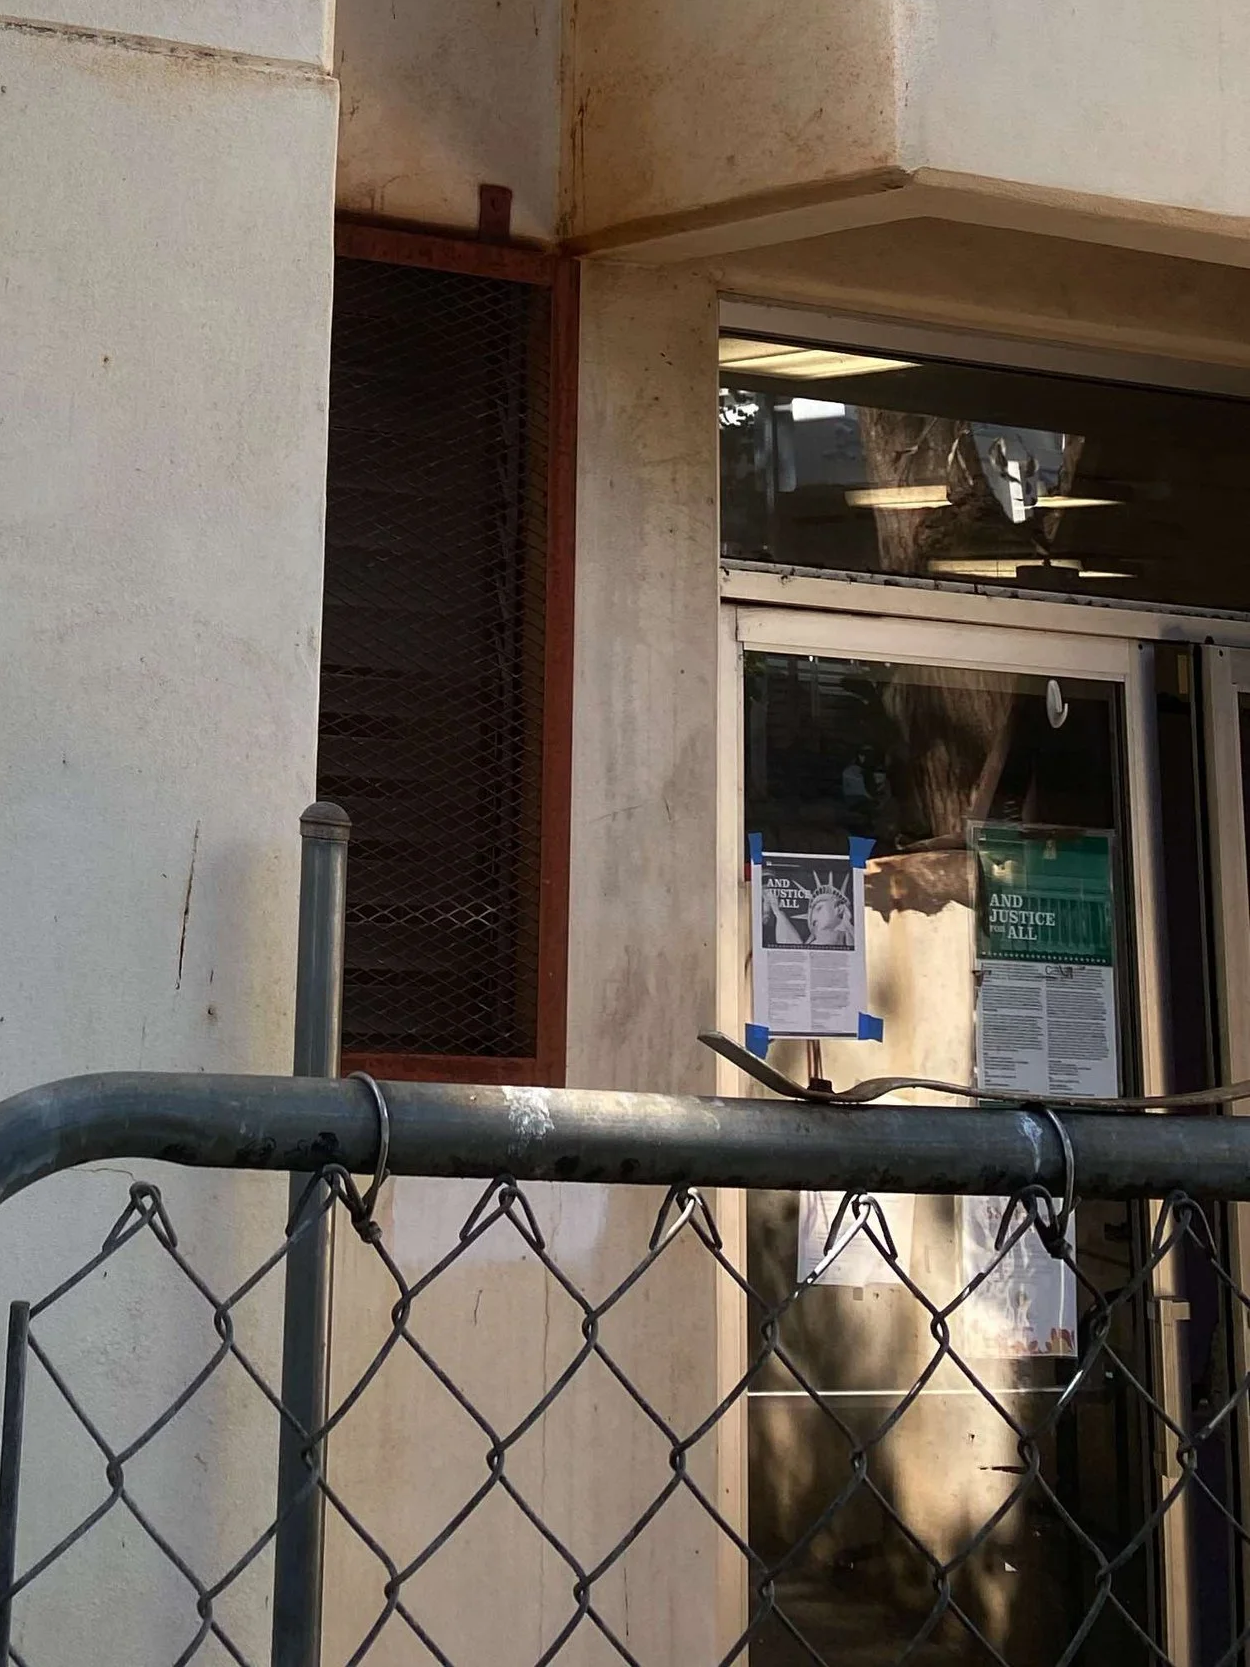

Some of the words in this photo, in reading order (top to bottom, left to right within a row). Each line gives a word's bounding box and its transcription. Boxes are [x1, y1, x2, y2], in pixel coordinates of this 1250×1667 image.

[767, 878, 791, 888] AND
[779, 898, 800, 908] ALL
[990, 893, 1024, 908] AND
[989, 908, 1056, 927] JUSTICE
[1007, 925, 1038, 941] ALL
